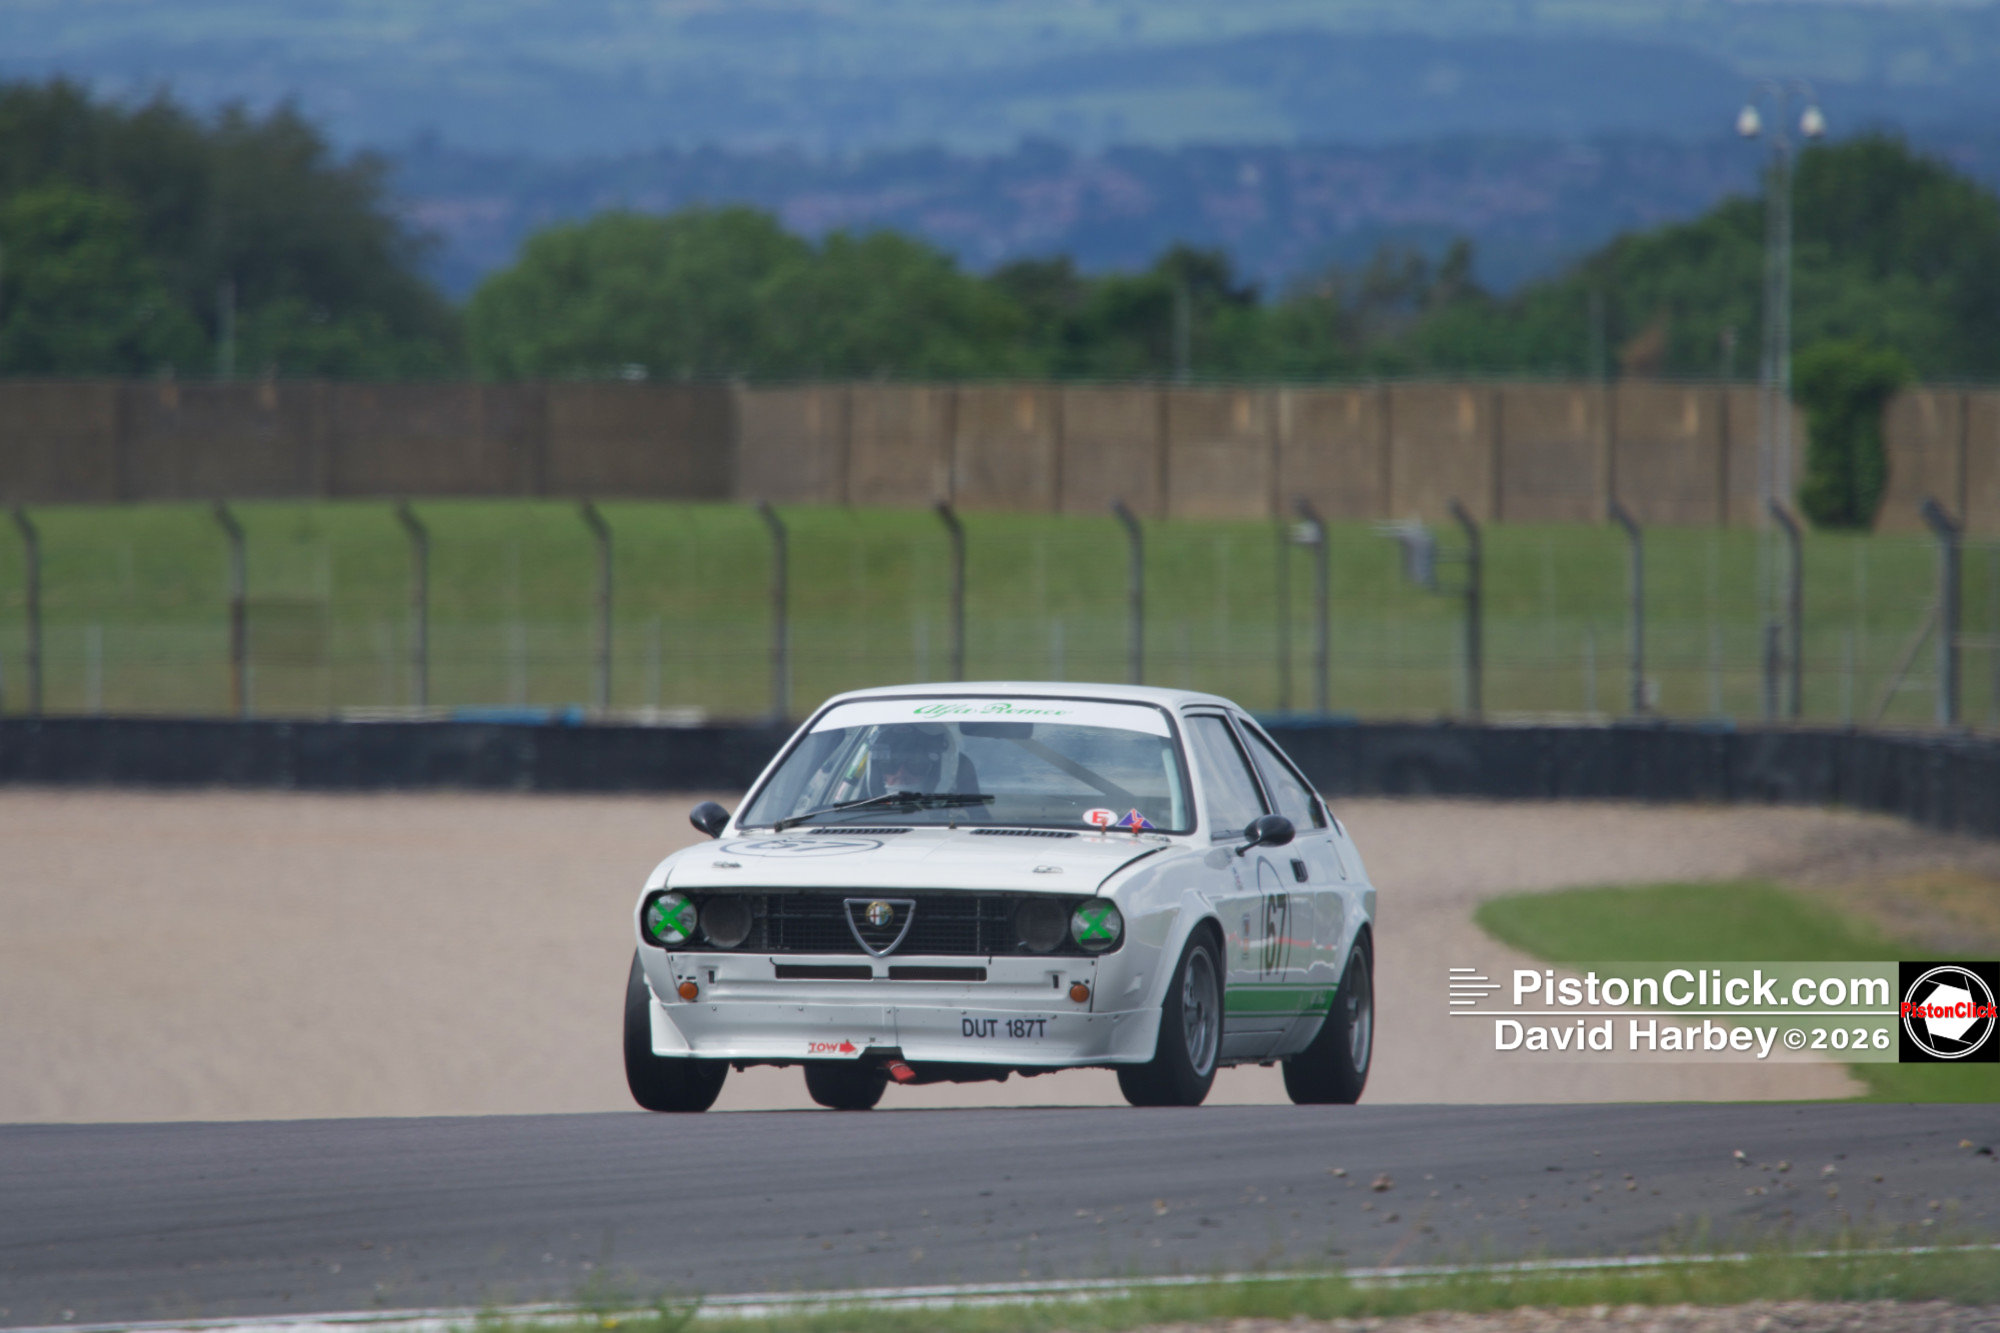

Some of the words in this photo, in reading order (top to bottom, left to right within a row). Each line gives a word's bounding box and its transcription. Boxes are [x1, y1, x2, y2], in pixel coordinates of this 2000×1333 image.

[913, 703, 976, 719] Alfa
[980, 702, 1073, 716] Romeo
[1265, 893, 1287, 976] 67
[962, 1019, 998, 1038] DUT
[1006, 1019, 1047, 1038] 187T
[809, 1042, 838, 1053] TOW
